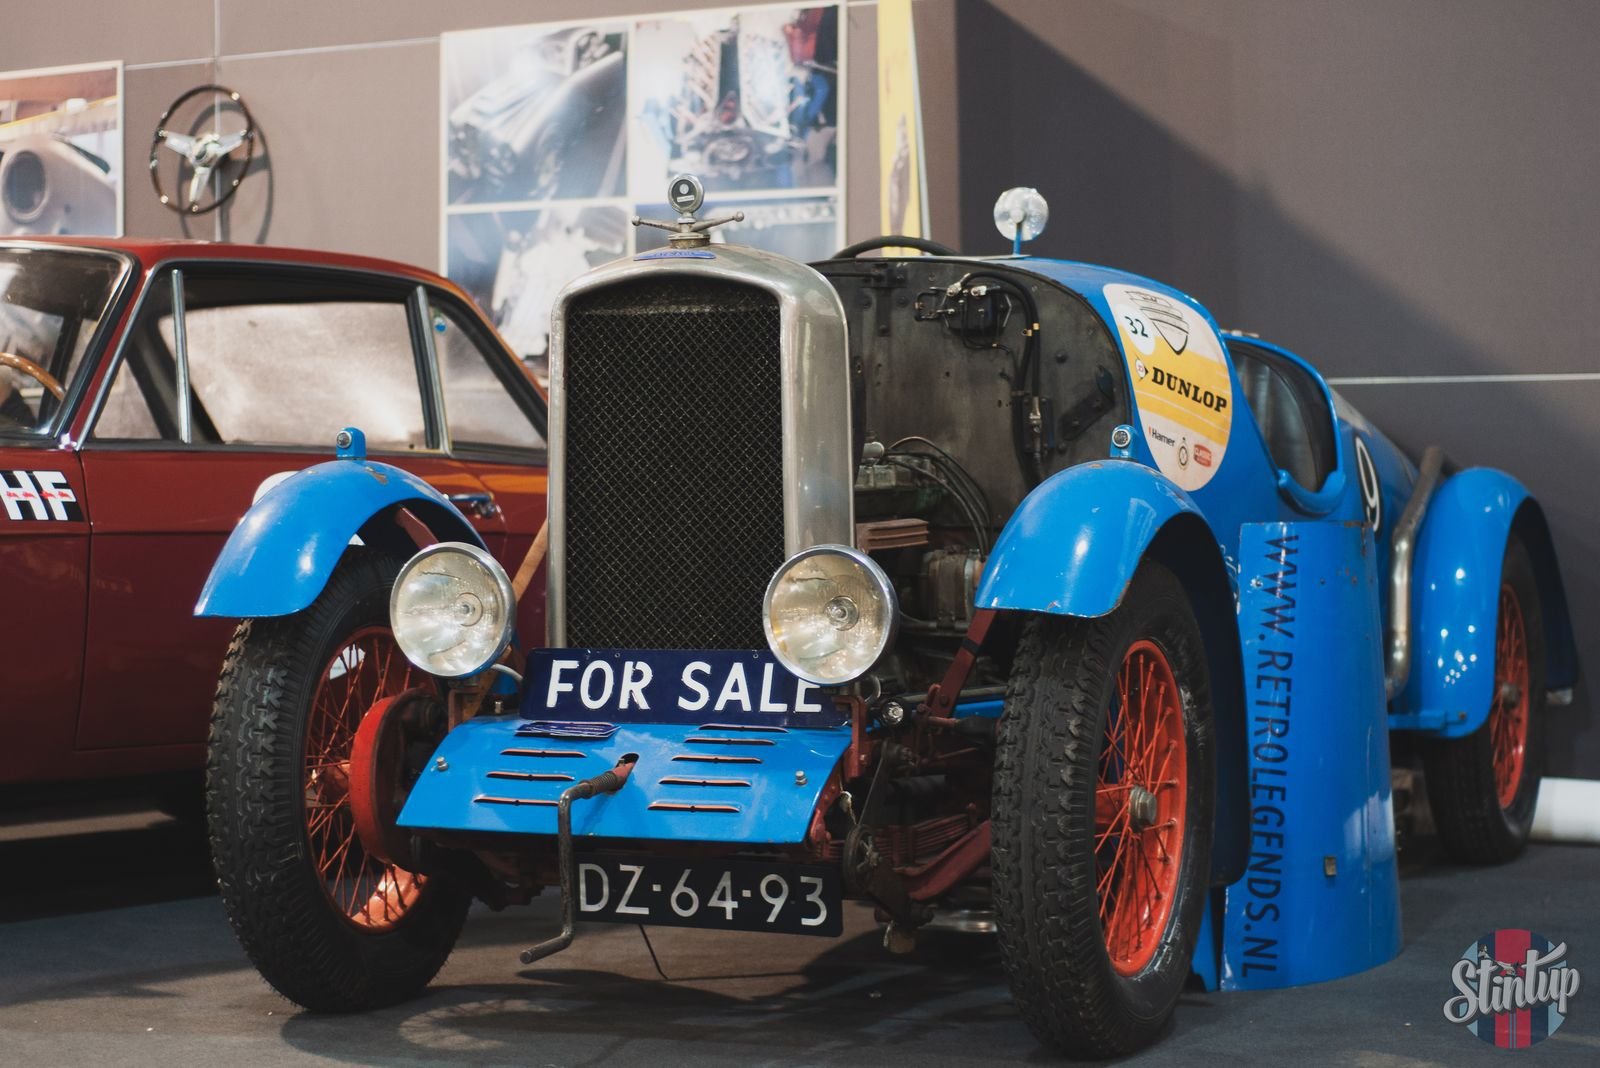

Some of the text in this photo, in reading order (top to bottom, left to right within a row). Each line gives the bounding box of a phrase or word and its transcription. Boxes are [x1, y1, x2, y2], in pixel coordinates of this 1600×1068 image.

[1124, 315, 1149, 339] 32
[1152, 366, 1228, 413] DUNLOP
[0, 470, 77, 521] HF
[546, 659, 823, 713] FOR SALE
[1241, 534, 1299, 978] WWW.RETROLEGENDS.NL
